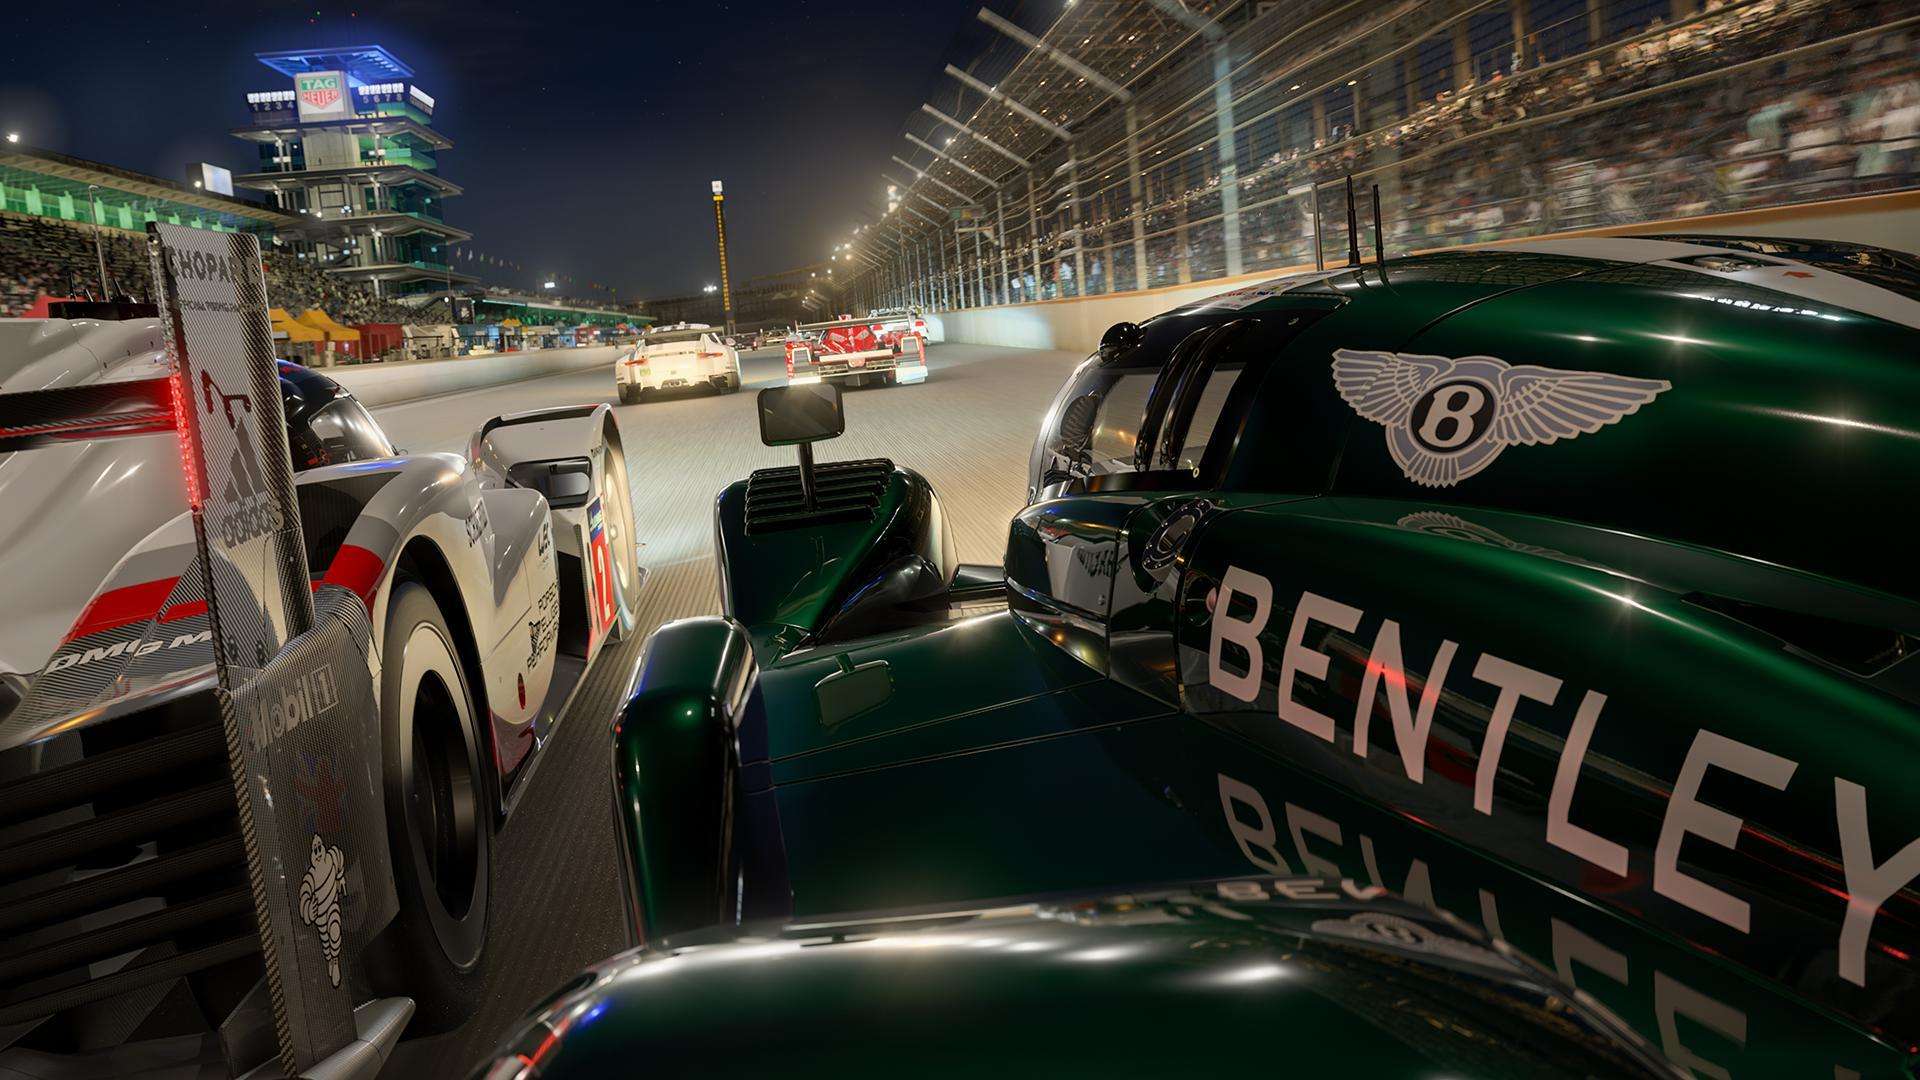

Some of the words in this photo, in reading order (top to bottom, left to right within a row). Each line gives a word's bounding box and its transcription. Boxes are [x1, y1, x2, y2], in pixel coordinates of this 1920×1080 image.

[302, 90, 340, 105] HEUER
[303, 79, 336, 90] TAG
[163, 245, 262, 284] CHOPARD
[222, 498, 285, 549] adidas
[42, 639, 164, 676] DMG
[249, 674, 314, 751] Mobil
[1209, 565, 1920, 988] BENTLEY
